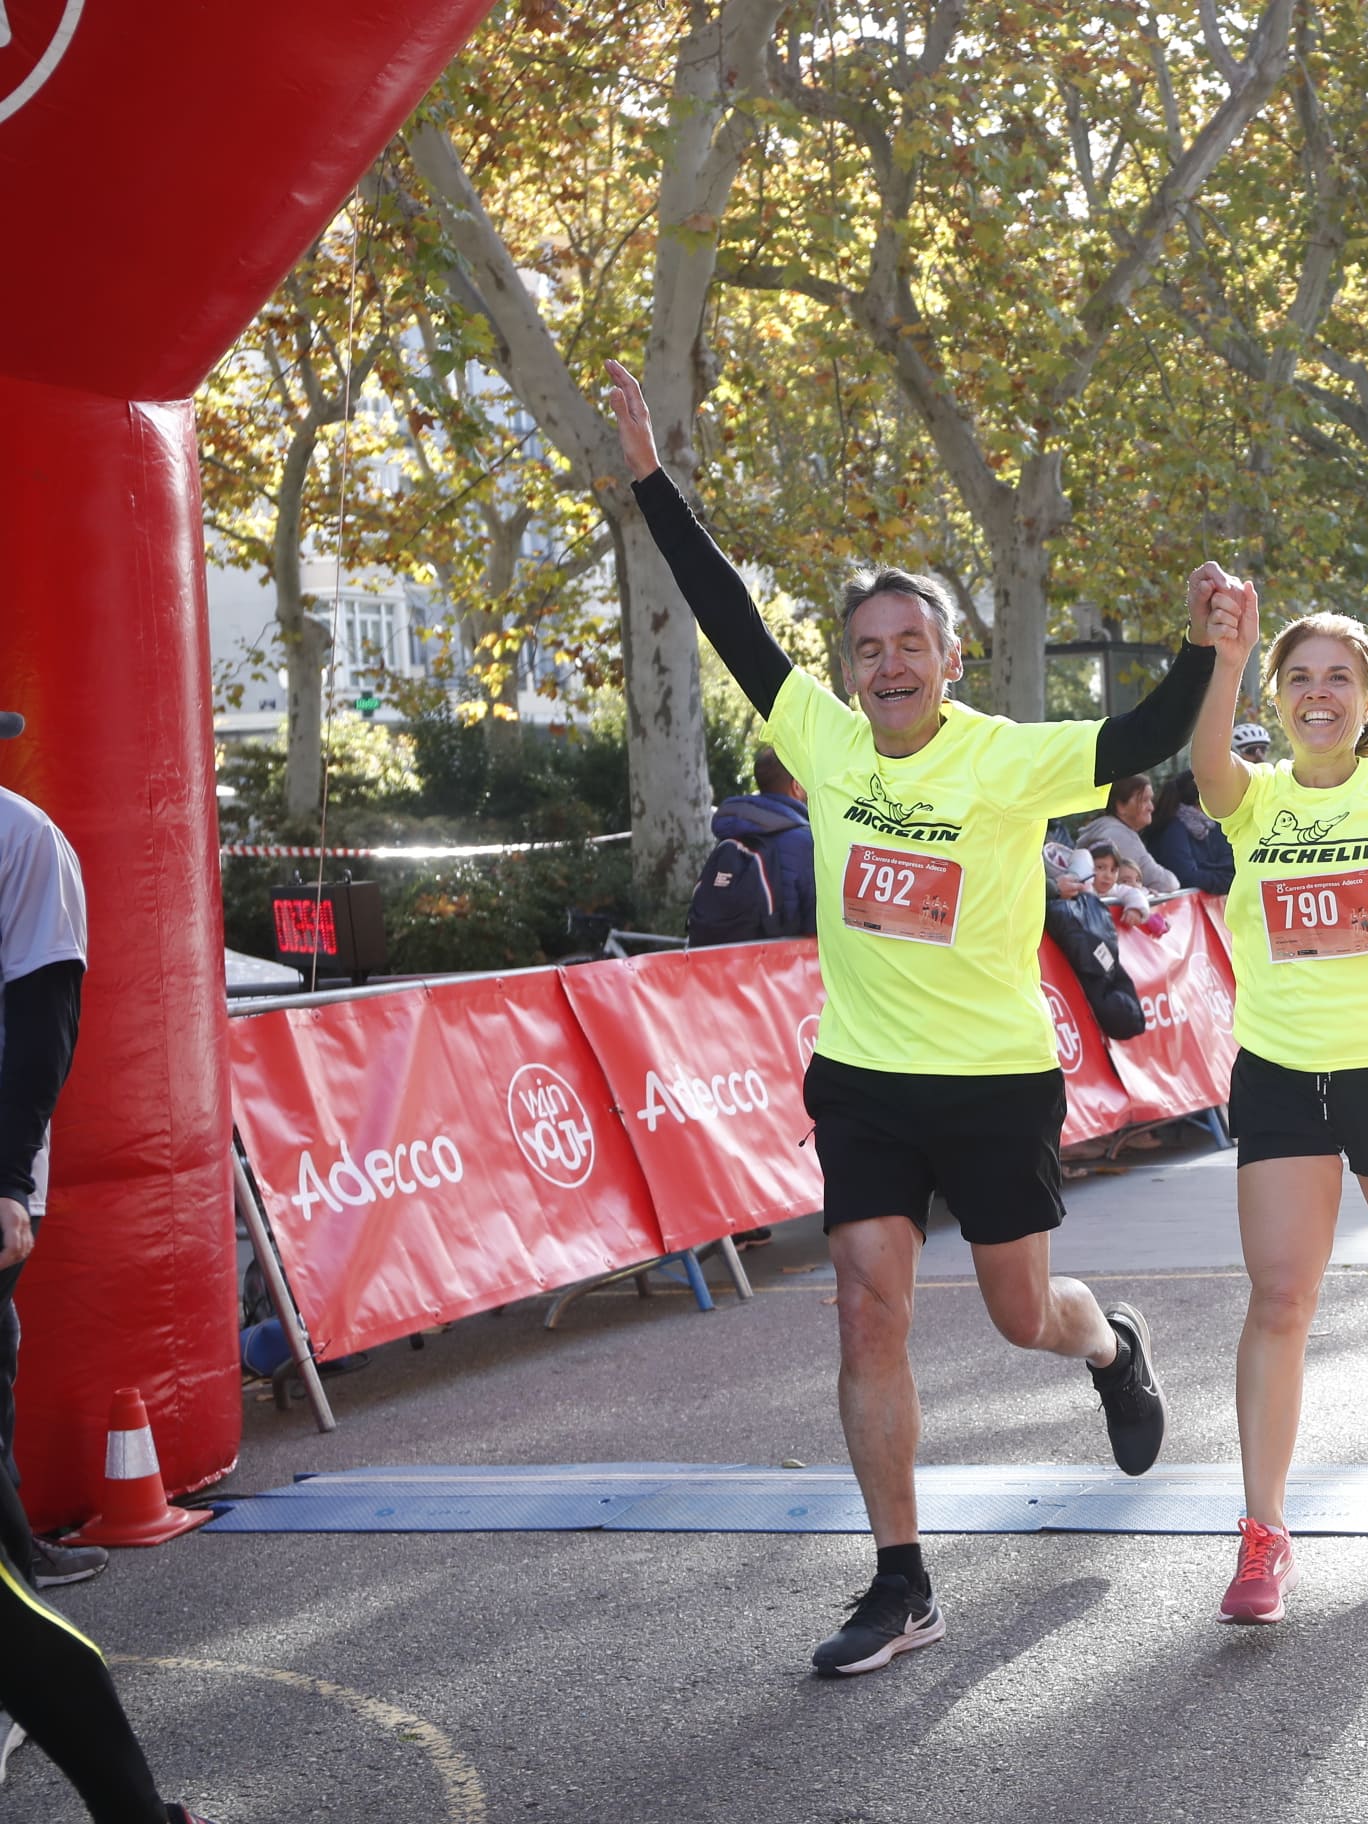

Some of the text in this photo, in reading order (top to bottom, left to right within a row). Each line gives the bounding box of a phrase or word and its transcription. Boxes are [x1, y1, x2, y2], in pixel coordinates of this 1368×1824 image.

[857, 863, 915, 907] 792
[1277, 889, 1339, 929] 790
[637, 1063, 768, 1132] Adecco
[292, 1135, 464, 1221] Adecco
